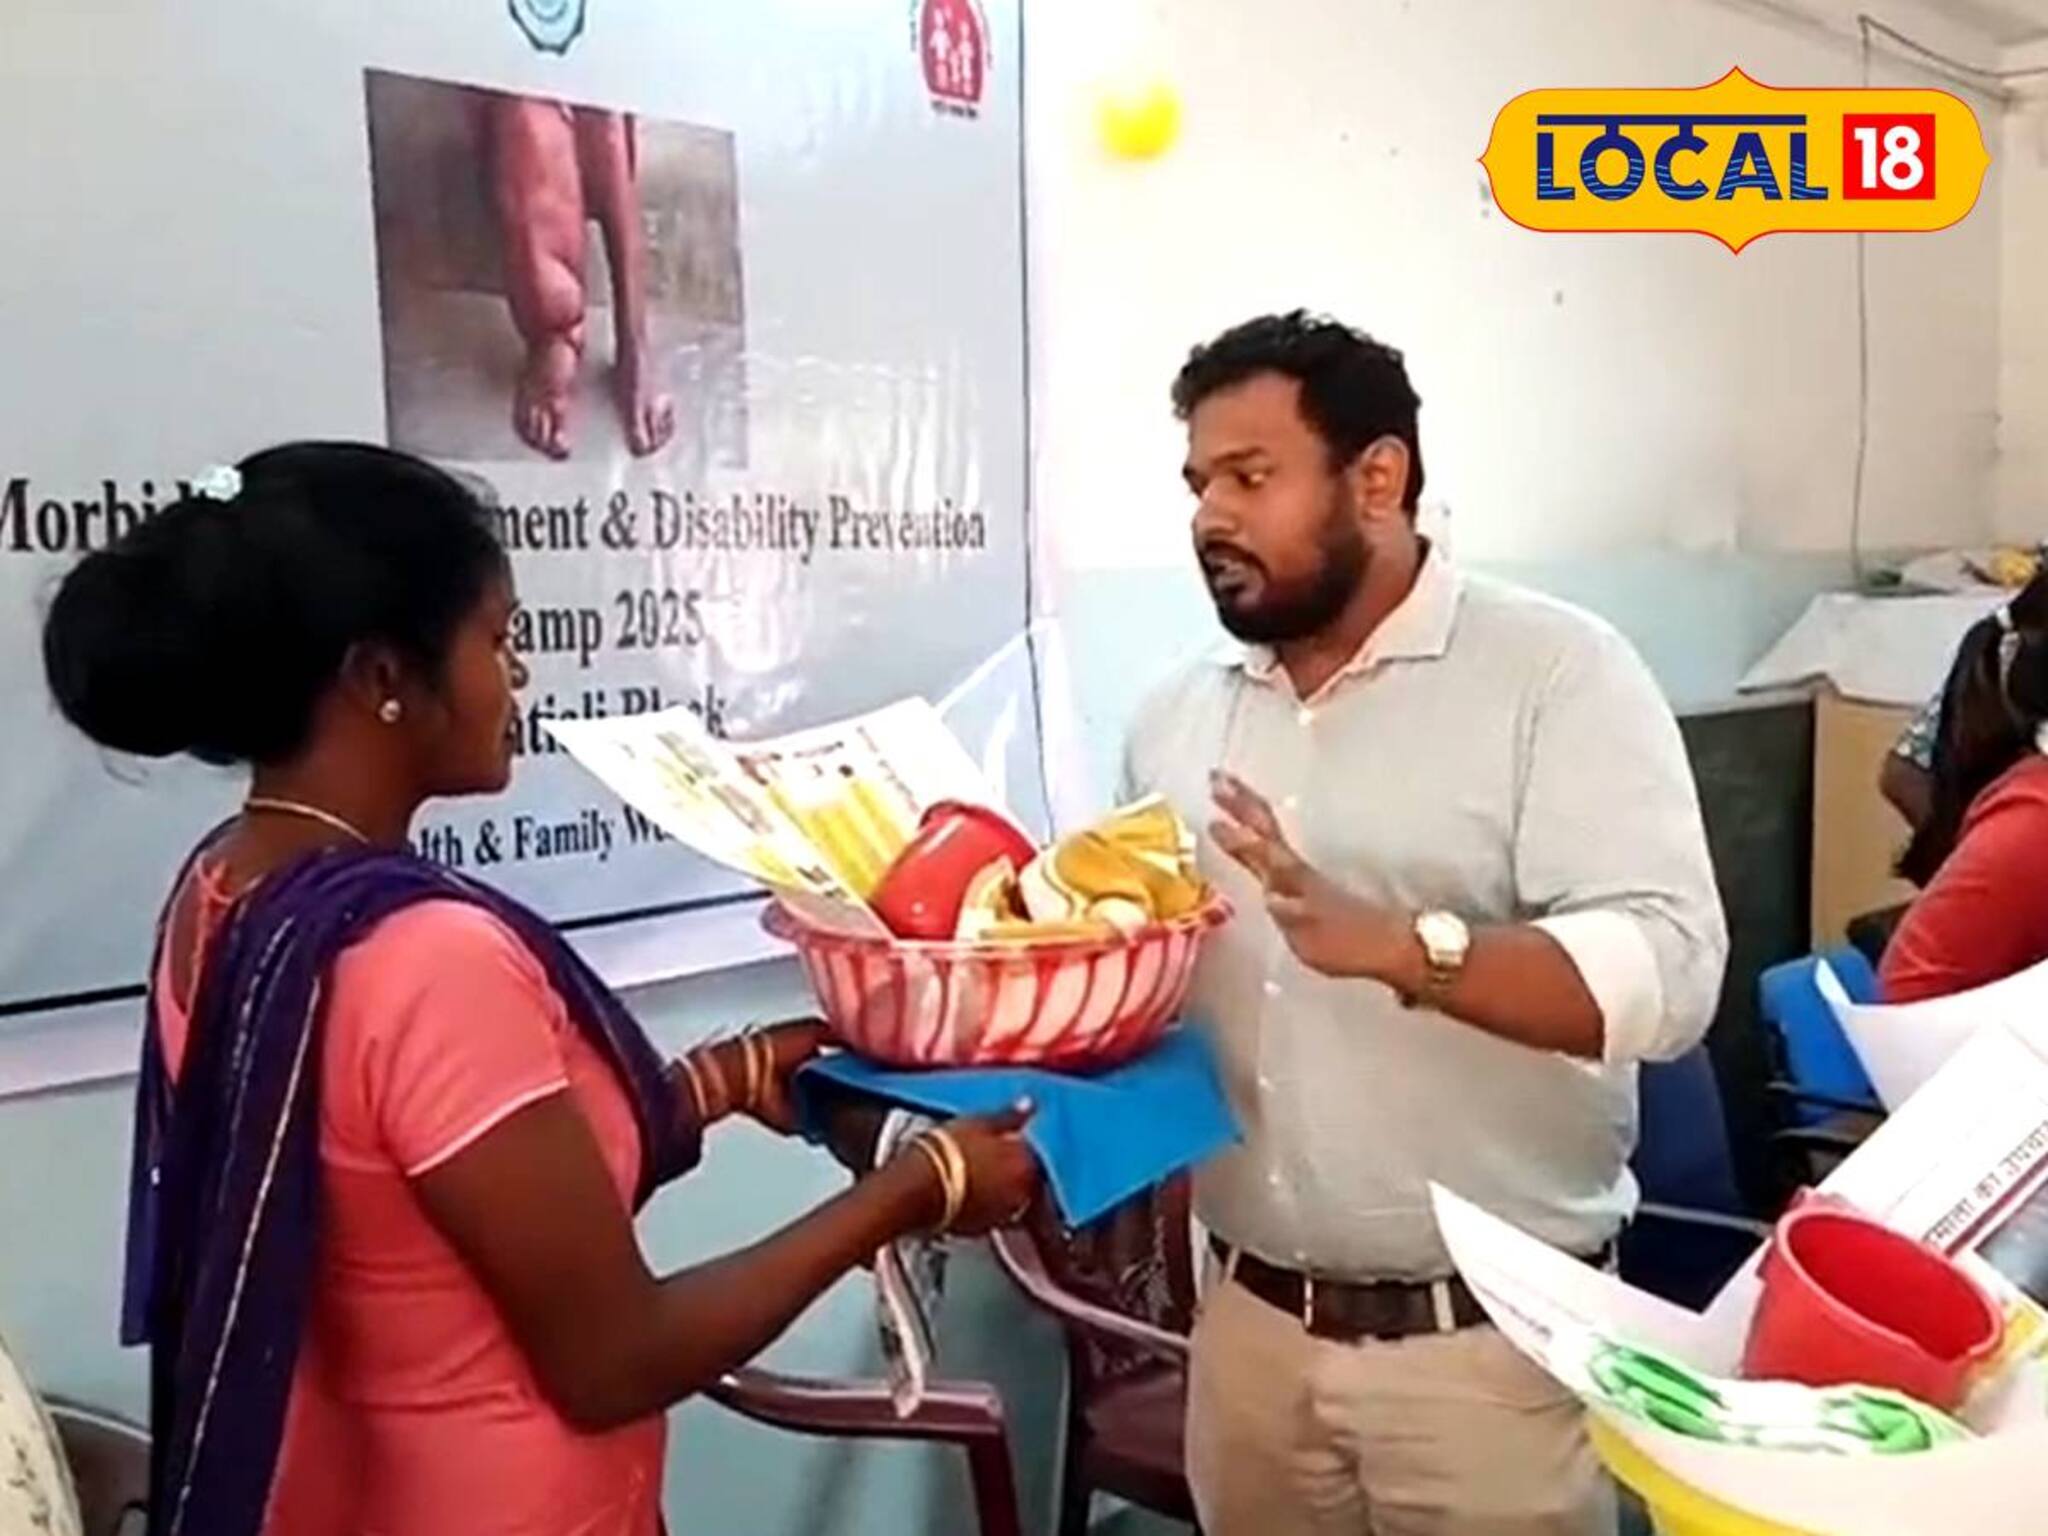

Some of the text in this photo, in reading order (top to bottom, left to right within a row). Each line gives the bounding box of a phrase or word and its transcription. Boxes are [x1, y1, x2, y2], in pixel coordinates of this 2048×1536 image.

[601, 490, 637, 550] &
[652, 490, 819, 564] Disability
[828, 494, 986, 550] Prevention
[511, 588, 703, 668] amp 2025
[420, 825, 463, 866] lth
[475, 819, 502, 865] &
[513, 810, 613, 861] Family
